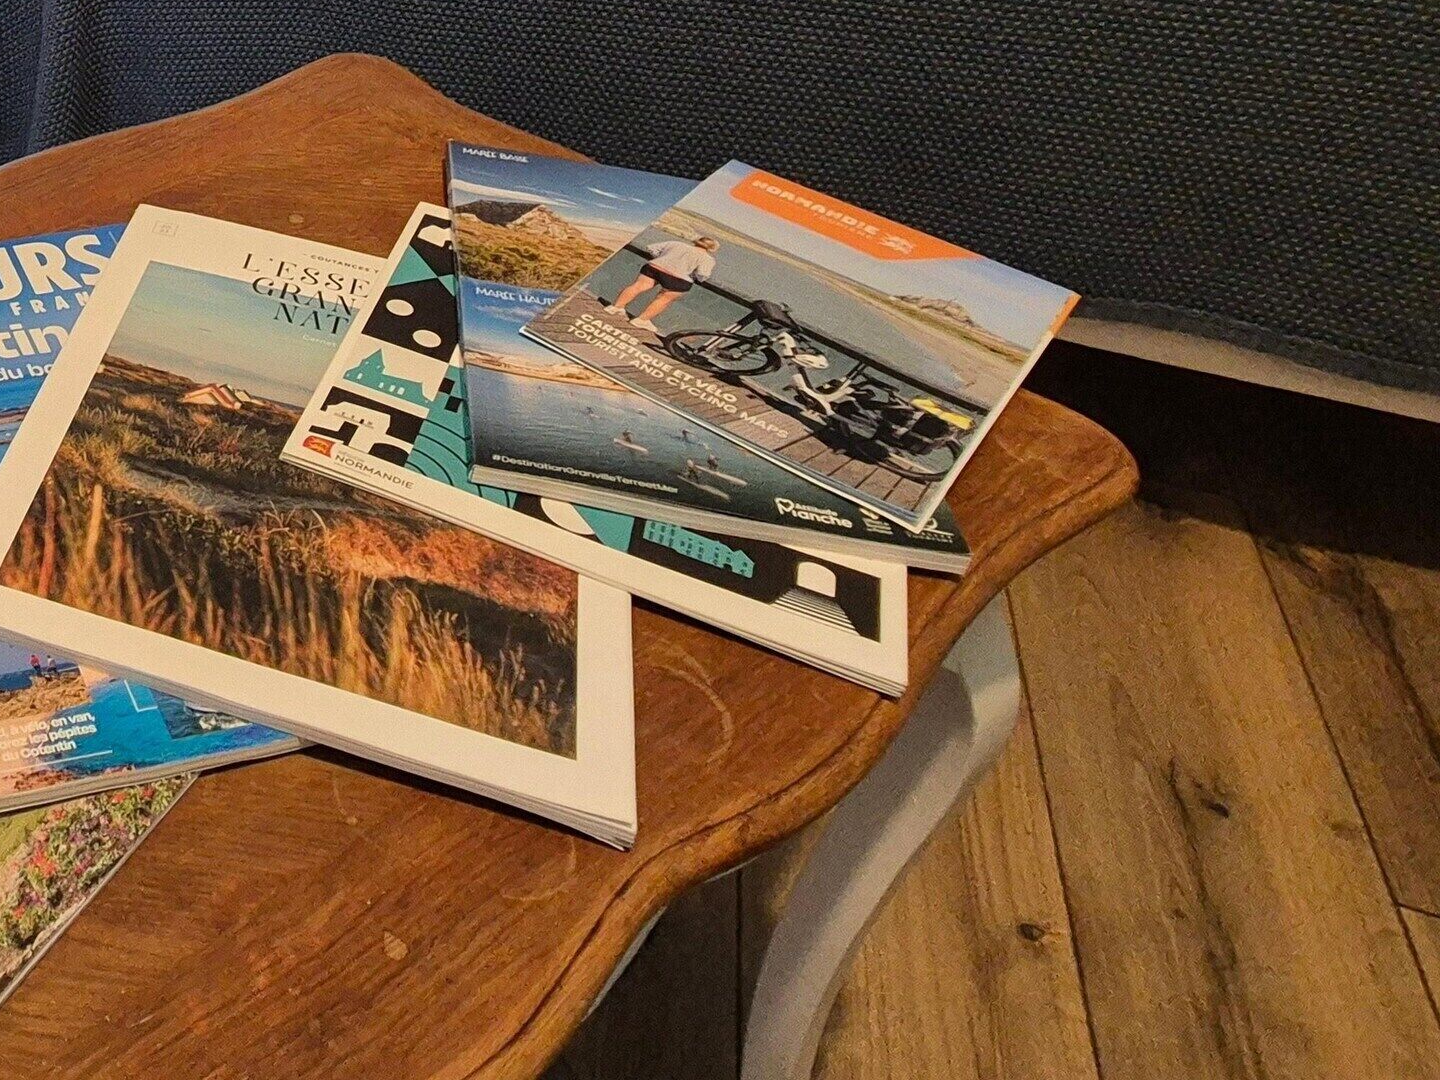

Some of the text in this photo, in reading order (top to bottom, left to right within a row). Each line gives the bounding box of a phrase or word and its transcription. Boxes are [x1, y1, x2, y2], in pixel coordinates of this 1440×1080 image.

[751, 180, 880, 235] NORMANDIE
[580, 313, 641, 346] CARTES
[574, 318, 673, 372] TOURISTIQUE
[673, 368, 694, 382] ET
[567, 325, 790, 439] TOURIST AND CYCLING MAPS
[335, 454, 415, 489] NORMANDIE
[51, 715, 68, 727] en
[21, 740, 78, 758] Cotentin
